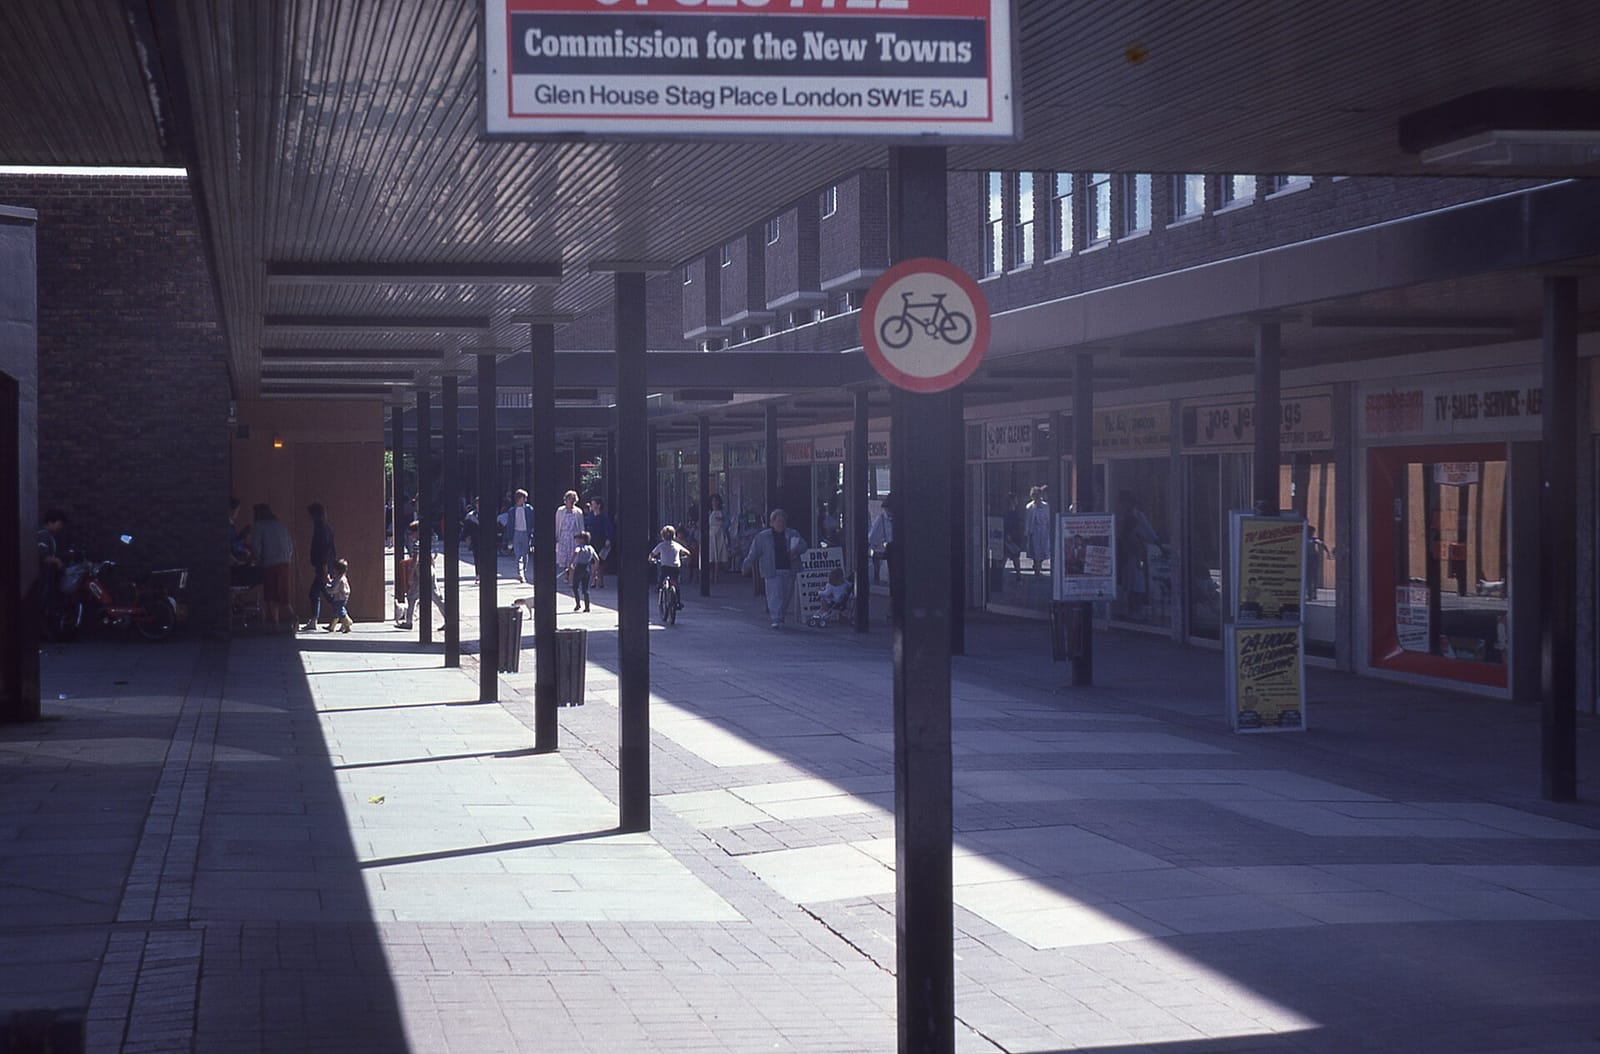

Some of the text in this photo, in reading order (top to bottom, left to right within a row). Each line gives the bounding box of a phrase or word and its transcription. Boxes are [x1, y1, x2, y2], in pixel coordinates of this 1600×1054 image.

[524, 28, 972, 63] Commission for the New Towns
[534, 84, 968, 109] Glen House Stag Place London SW1E 5AJ
[1435, 395, 1448, 420] TV
[1452, 393, 1478, 419] SALES
[1483, 390, 1520, 417] SERVICE
[810, 552, 828, 560] DRY
